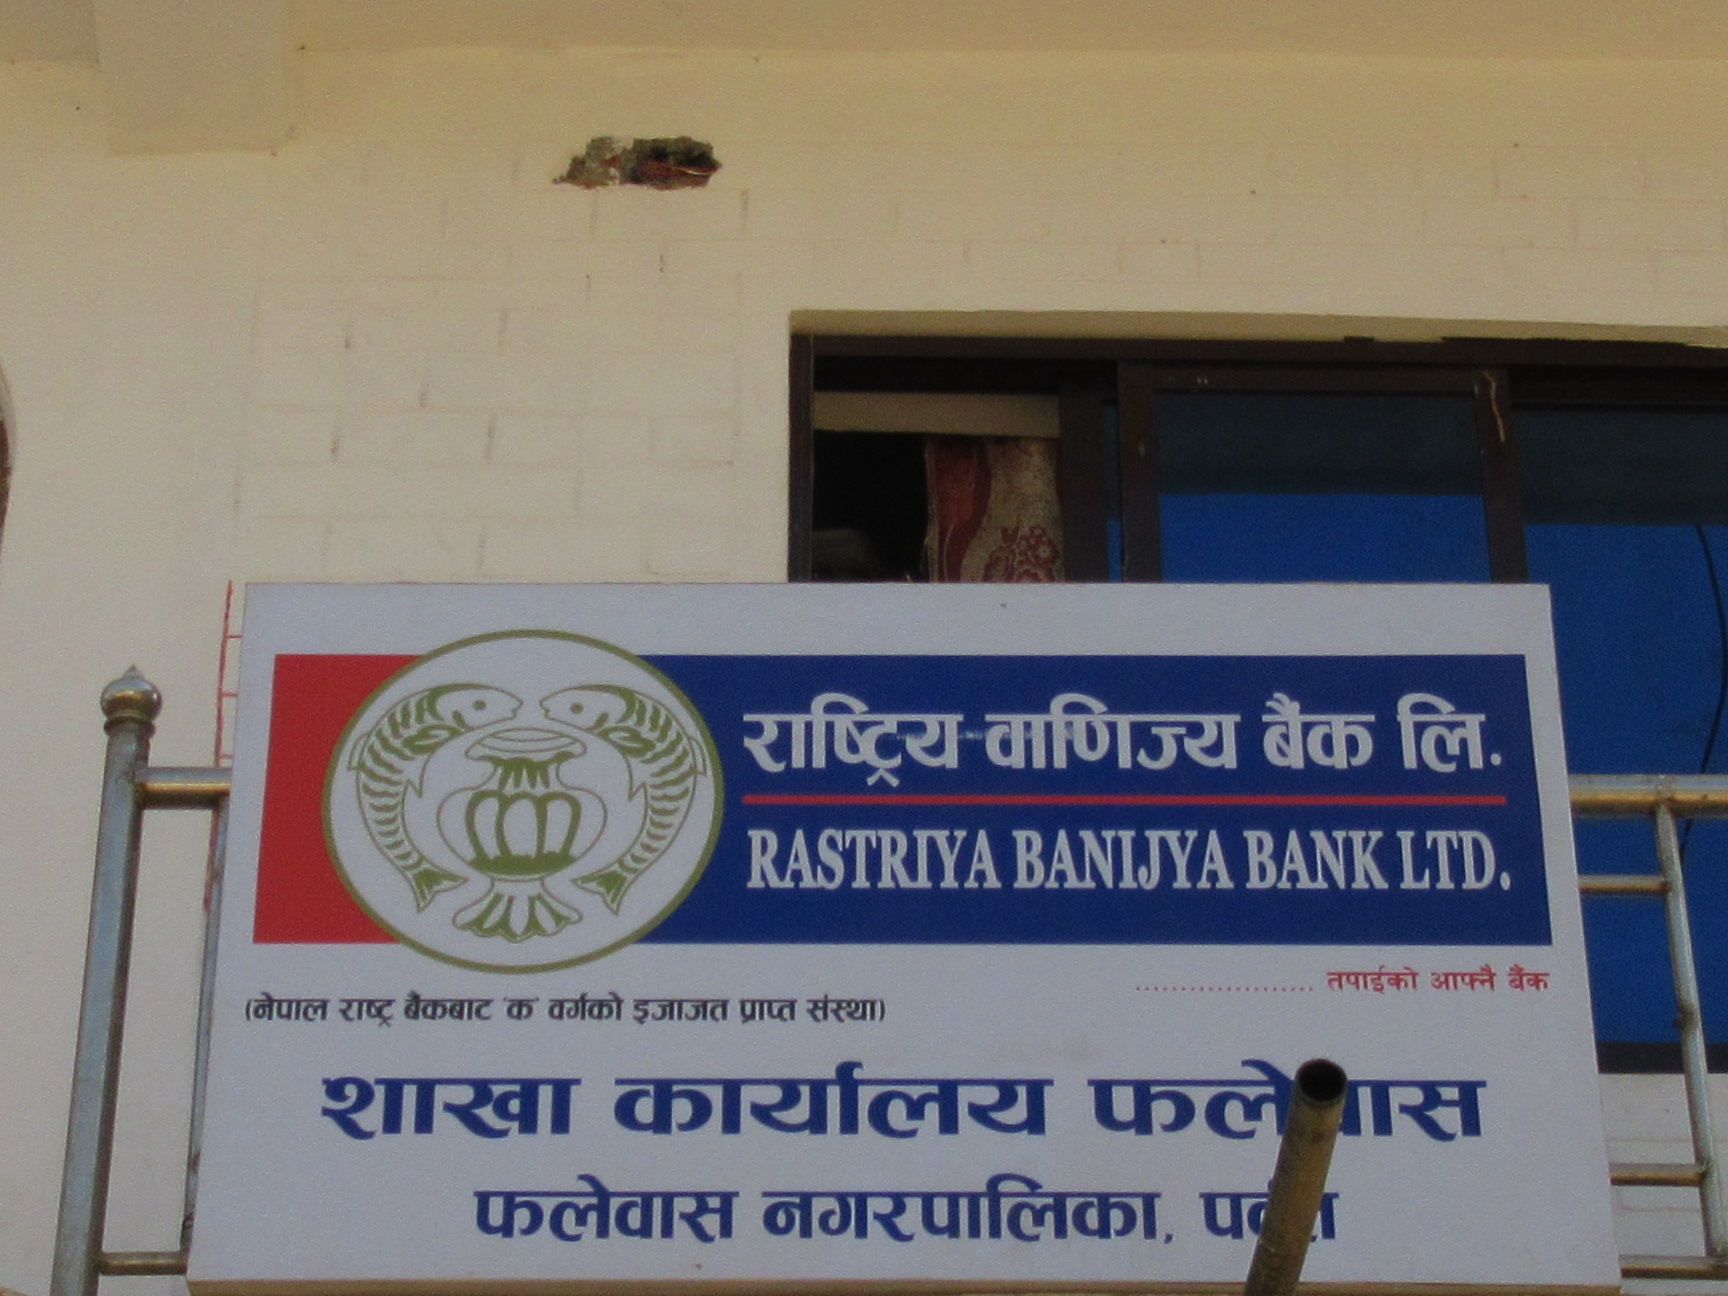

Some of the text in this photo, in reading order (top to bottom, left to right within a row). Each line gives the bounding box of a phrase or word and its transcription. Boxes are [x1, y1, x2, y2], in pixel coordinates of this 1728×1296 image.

[742, 692, 1502, 788] राष्ट्रिय वाणिज्य बैंक लि.
[746, 828, 1511, 891] RASTRIYA BANIJYA BANK LTD.
[245, 991, 330, 1022] (नेपाल
[338, 998, 397, 1027] राष्ट्र
[548, 991, 625, 1021] वर्गको
[633, 998, 730, 1025] इजाजत
[738, 998, 798, 1025] प्राप्त
[806, 994, 886, 1024] संस्था)
[321, 1076, 582, 1141] शाखा
[613, 1060, 1055, 1140] कार्यालय
[473, 1173, 740, 1244] फलेवास
